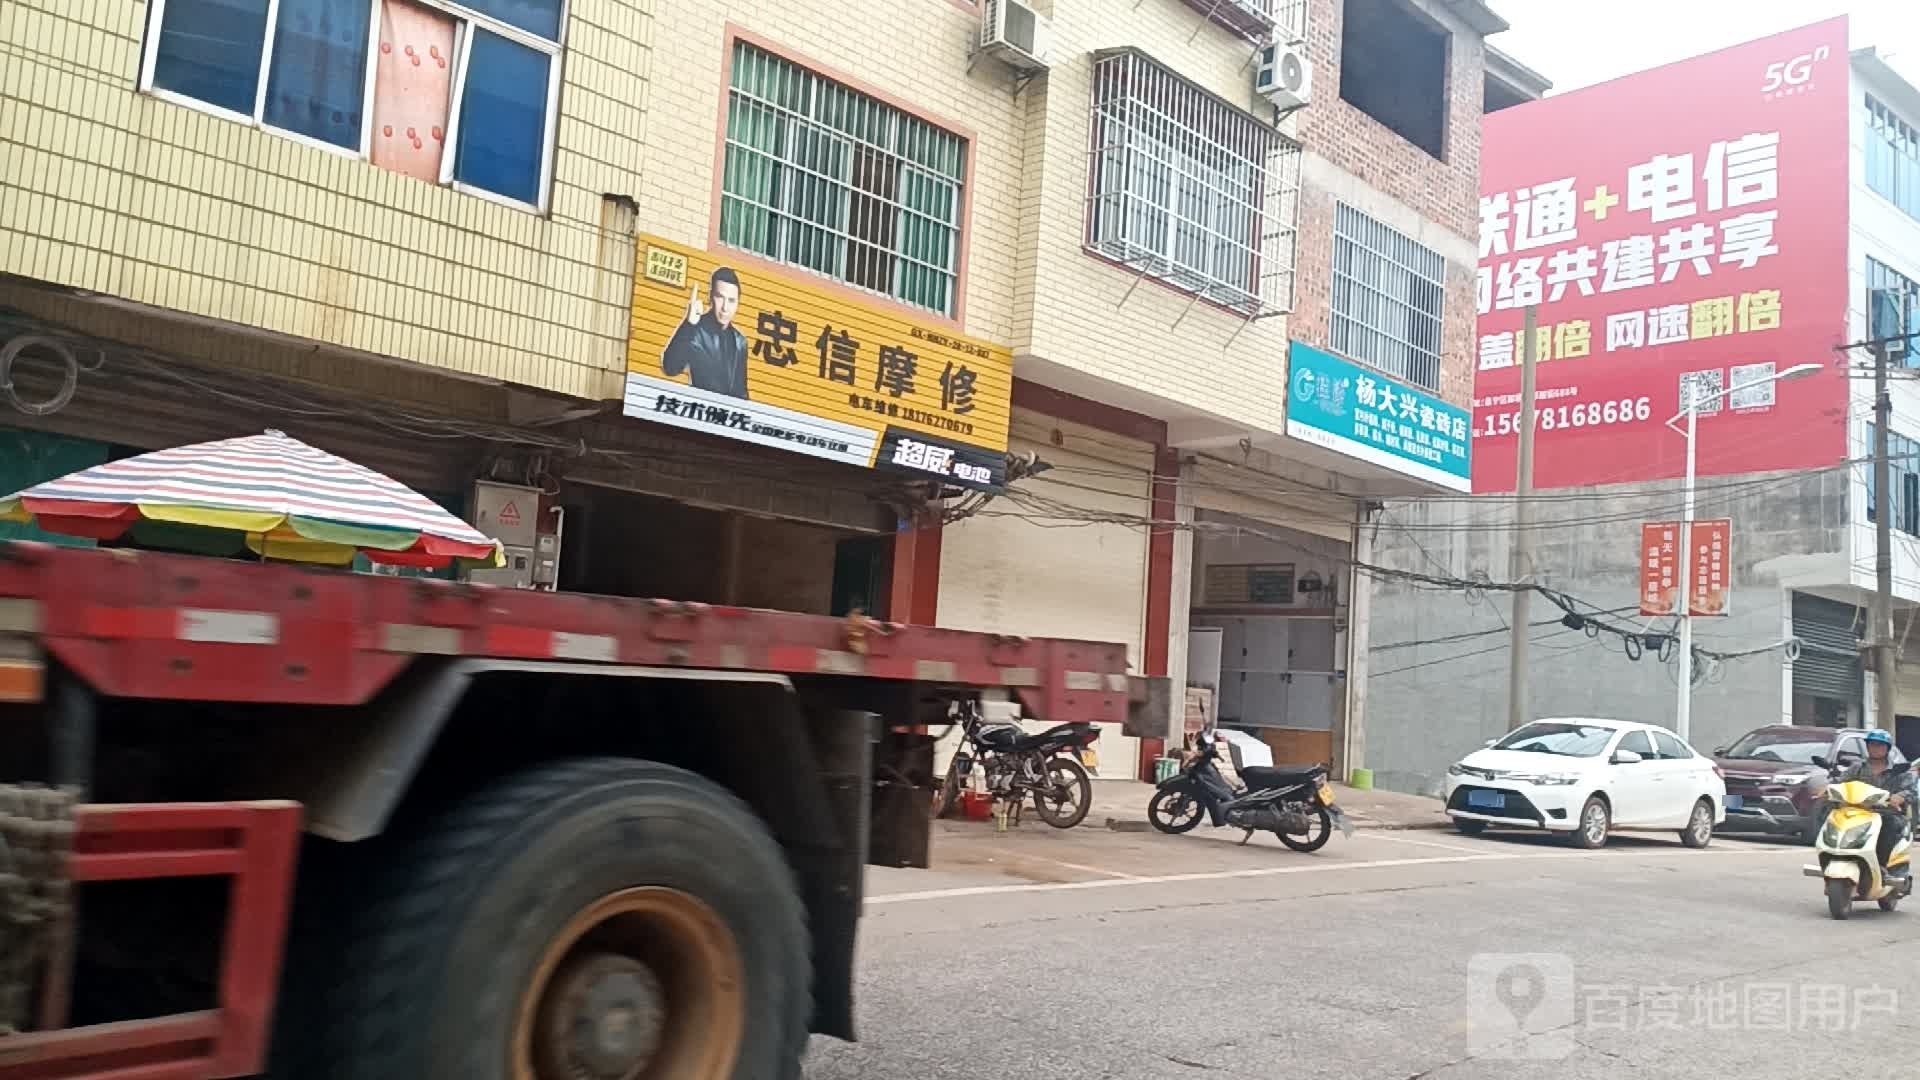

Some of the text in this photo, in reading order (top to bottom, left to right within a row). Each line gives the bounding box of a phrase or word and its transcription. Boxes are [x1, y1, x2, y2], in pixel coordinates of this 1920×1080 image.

[1606, 289, 1781, 352] 网速翻倍
[752, 310, 977, 414] 忠信摩修
[653, 394, 752, 432] 技术领先
[849, 393, 899, 417] 电车维修
[1355, 374, 1467, 441] 杨大兴瓷砖店
[892, 438, 992, 484] 超威 电池
